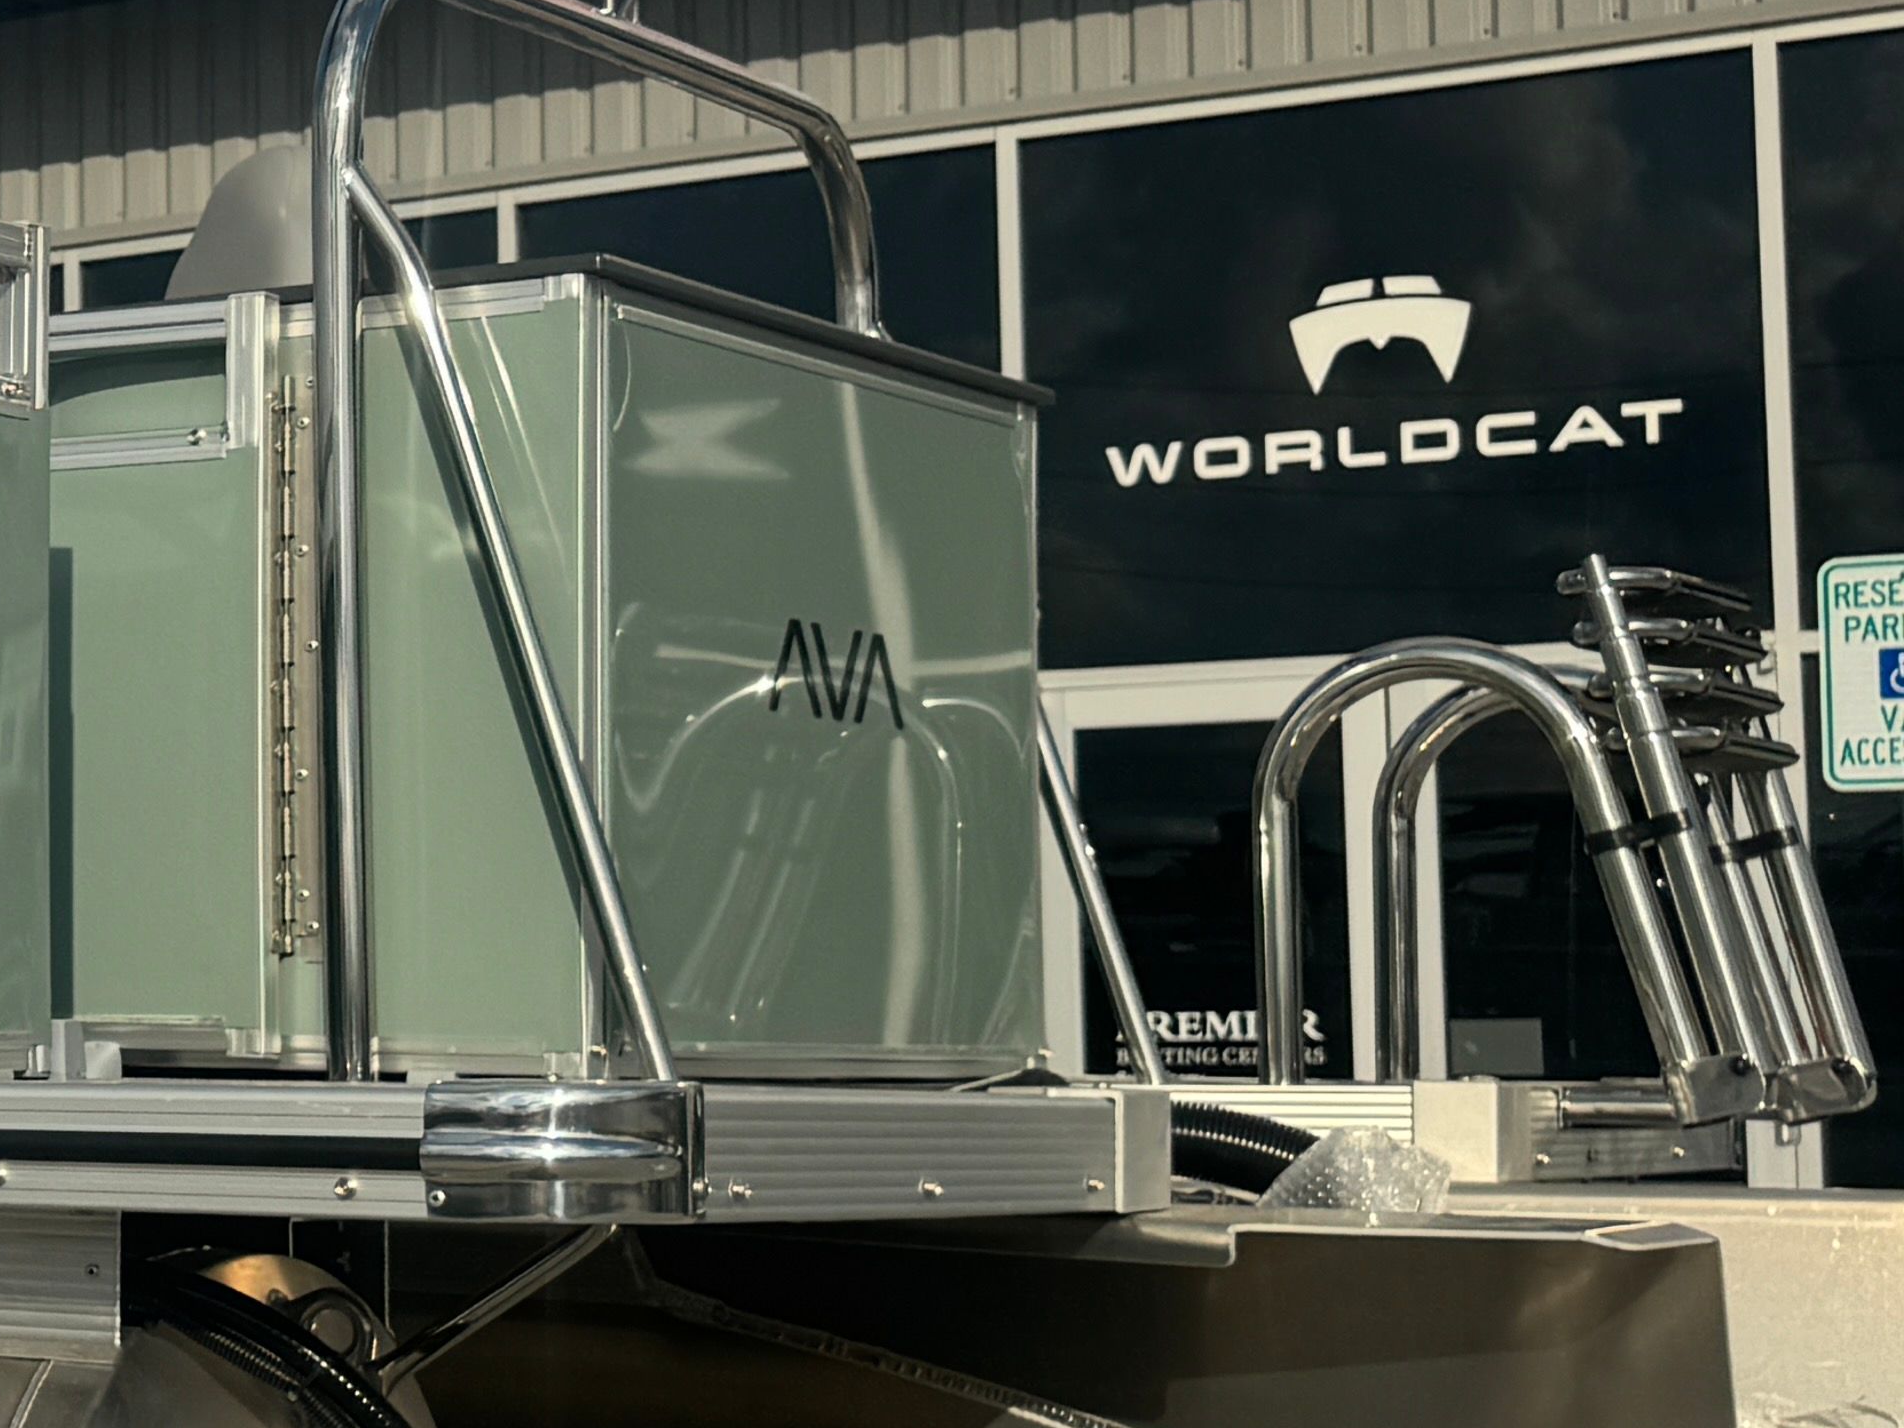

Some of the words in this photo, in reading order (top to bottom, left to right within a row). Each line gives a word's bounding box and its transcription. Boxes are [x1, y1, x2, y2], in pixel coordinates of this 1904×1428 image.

[1104, 398, 1683, 487] WORLDCAT
[769, 618, 904, 730] AVA
[1115, 1008, 1327, 1042] REMIR
